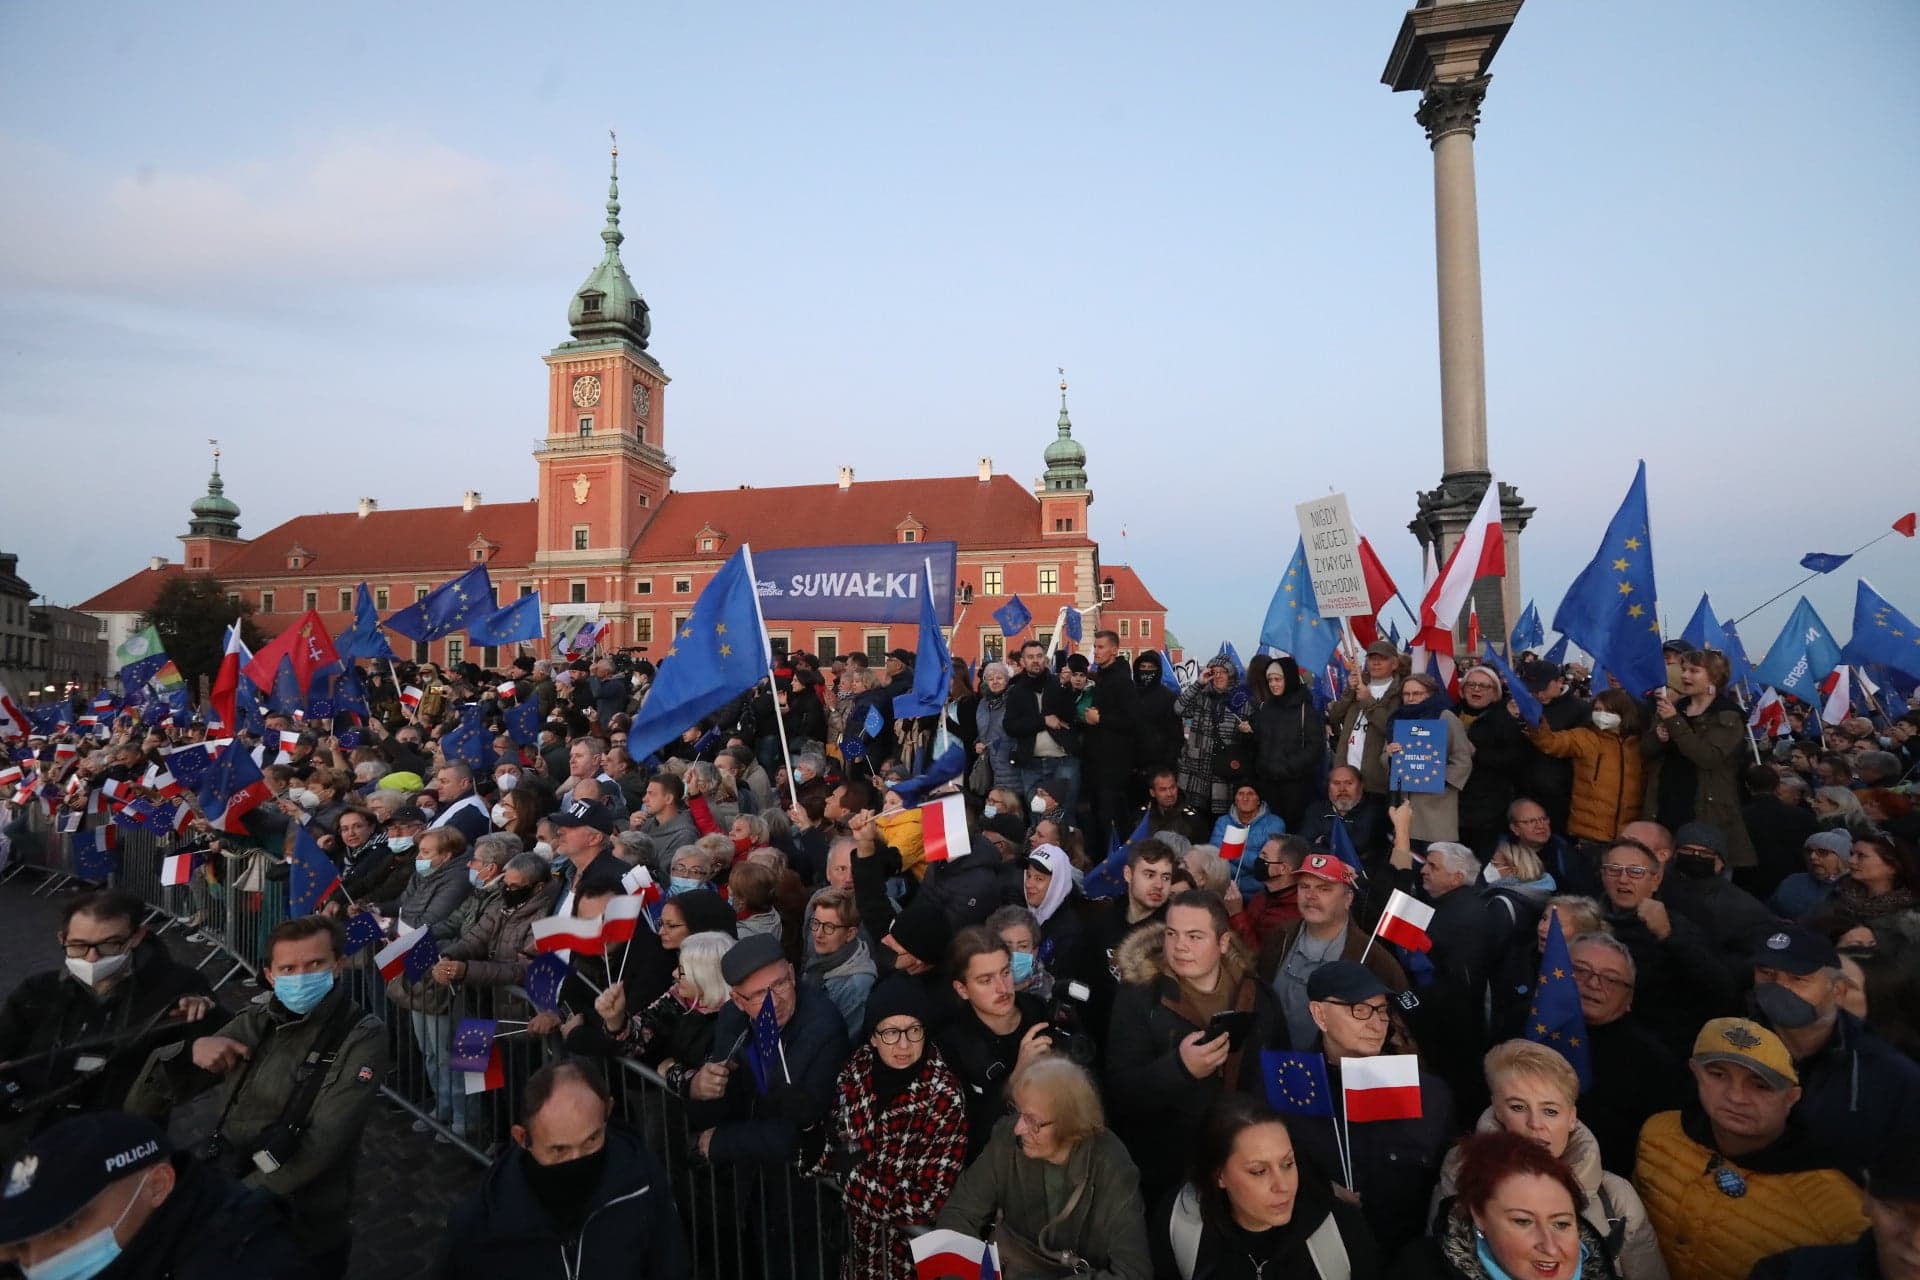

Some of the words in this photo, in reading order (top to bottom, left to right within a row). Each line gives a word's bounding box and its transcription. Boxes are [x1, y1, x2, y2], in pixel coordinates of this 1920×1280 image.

[1310, 506, 1338, 527] NIGDY
[789, 572, 918, 598] SUWAŁKI
[1313, 576, 1361, 596] POCHODNI
[105, 1139, 159, 1174] POLICJA
